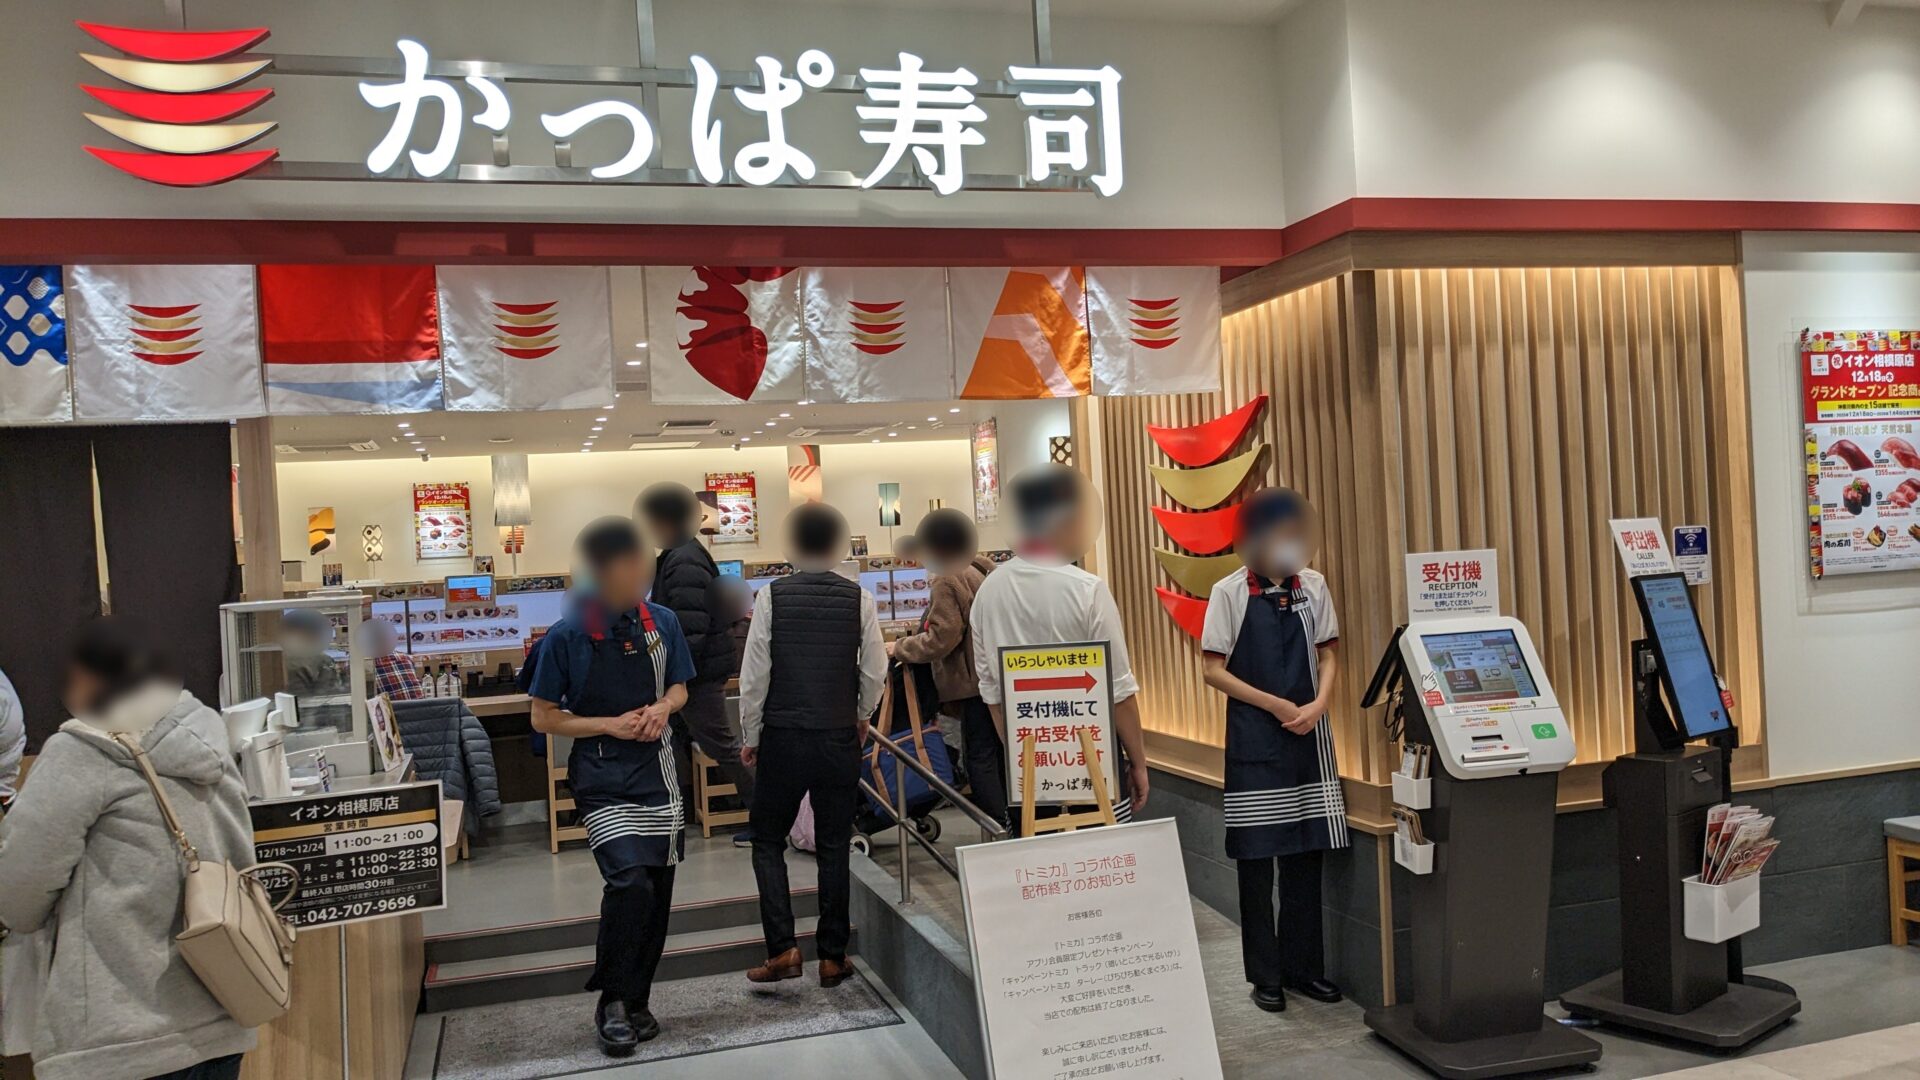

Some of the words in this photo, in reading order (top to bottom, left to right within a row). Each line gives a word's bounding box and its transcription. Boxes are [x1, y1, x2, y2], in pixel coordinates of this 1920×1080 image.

[358, 38, 1123, 198] かっぱ寿司
[1810, 384, 1887, 399] グランドオープン
[1621, 529, 1660, 551] 呼出機
[1636, 552, 1655, 560] CALLER
[1422, 560, 1482, 583] 受付機
[1428, 581, 1478, 591] RECEPTION
[1007, 653, 1097, 668] いらっしゃいませ！
[1016, 700, 1098, 719] 受付機にて
[289, 795, 400, 821] イオン相模原店
[323, 818, 369, 833] 営業時間
[301, 884, 333, 898] 最終入店
[333, 877, 395, 894] 閉店時間30分前
[1022, 871, 1137, 900] 配布終了のお知らせ
[1067, 908, 1103, 922] お客様各位
[1026, 941, 1154, 969] アプリ会員限定プレゼントキャンペーン
[1043, 994, 1155, 1021] 当店での配布は終了となりました。
